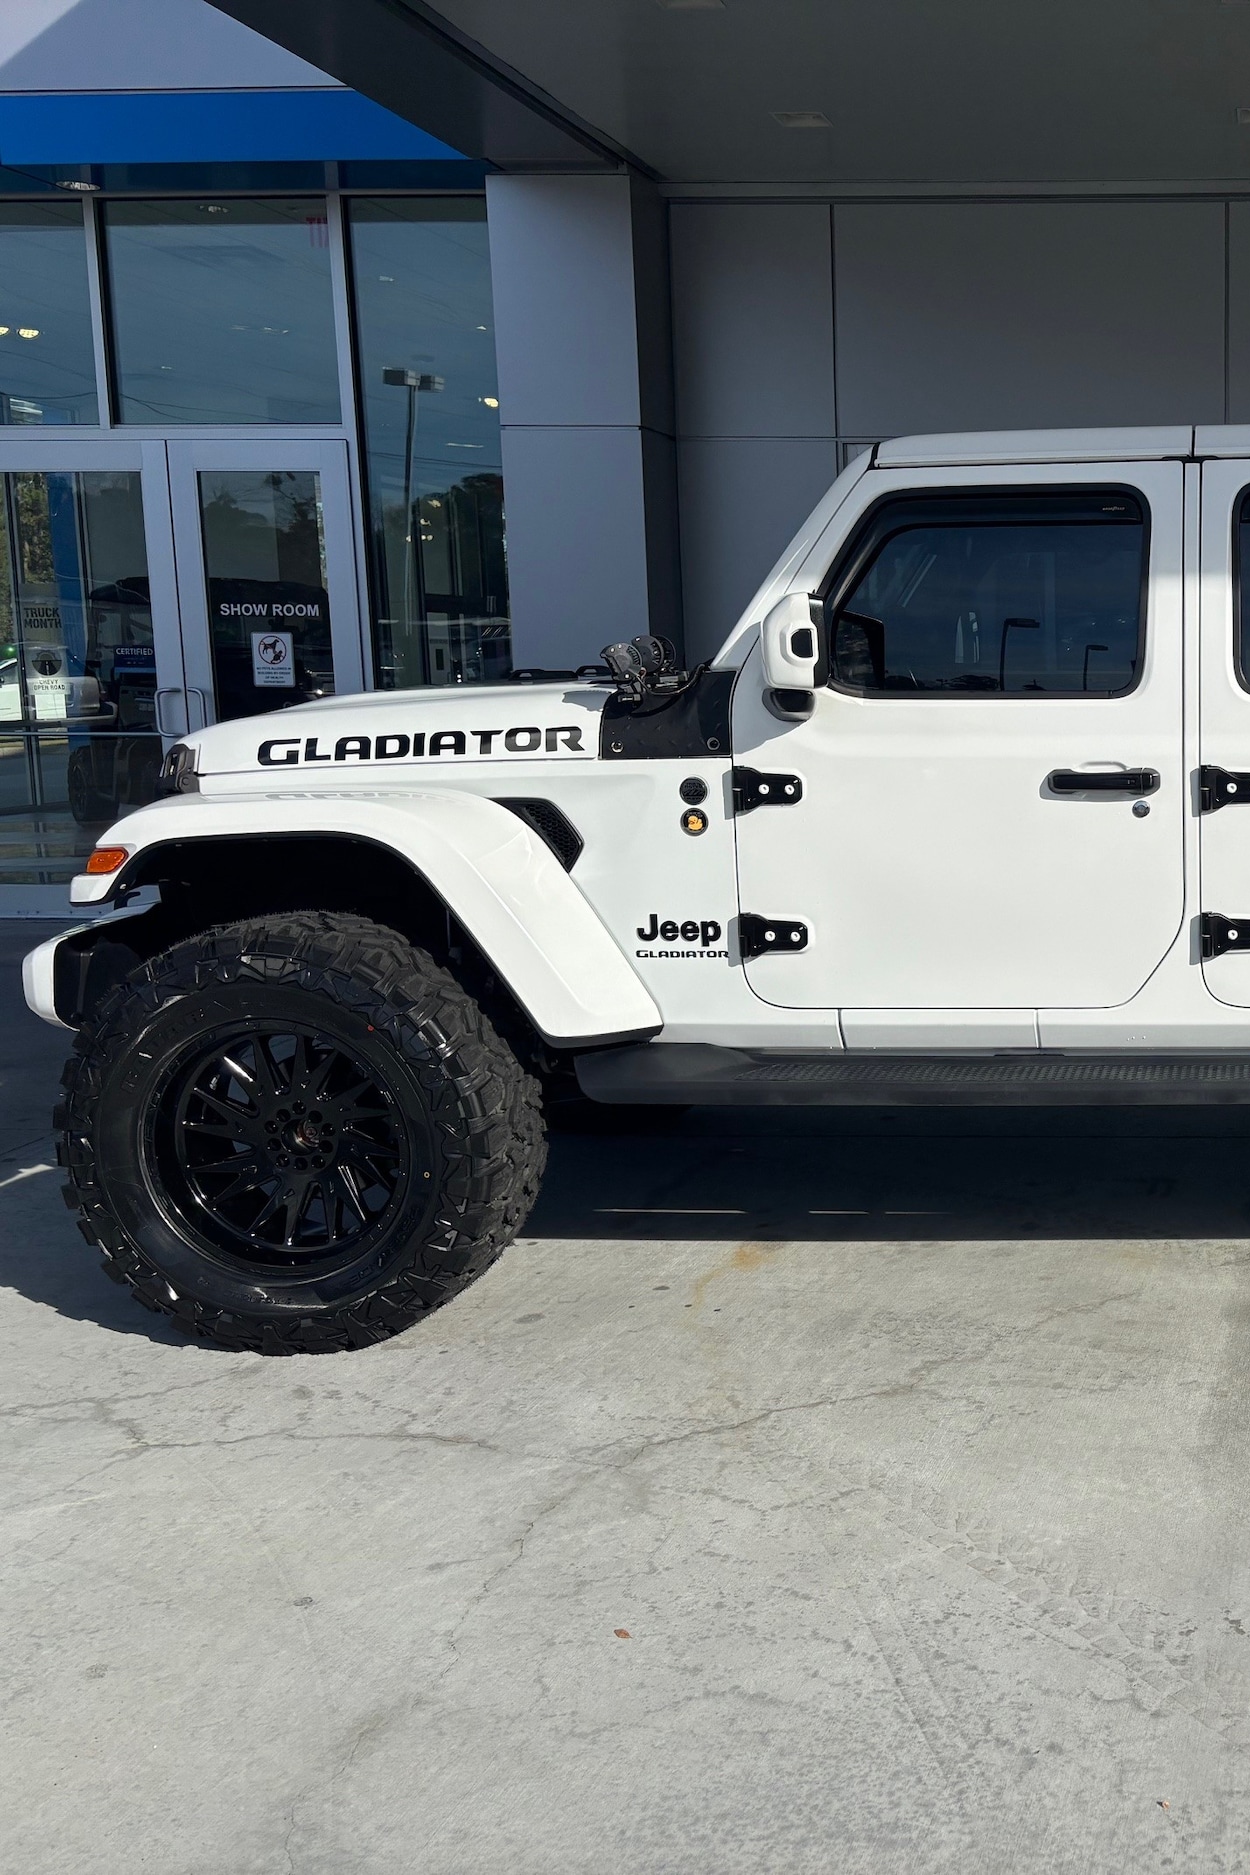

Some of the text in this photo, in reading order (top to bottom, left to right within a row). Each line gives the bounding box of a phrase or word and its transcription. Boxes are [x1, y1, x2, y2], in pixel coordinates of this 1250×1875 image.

[23, 607, 60, 618] TRUCK
[220, 603, 320, 616] SHOW ROOM
[24, 618, 63, 629] MONTH
[115, 647, 154, 656] CERTIFIED
[257, 726, 586, 765] GLADIATOR
[636, 913, 721, 947] Jeep
[636, 949, 730, 959] GLADIATOR
